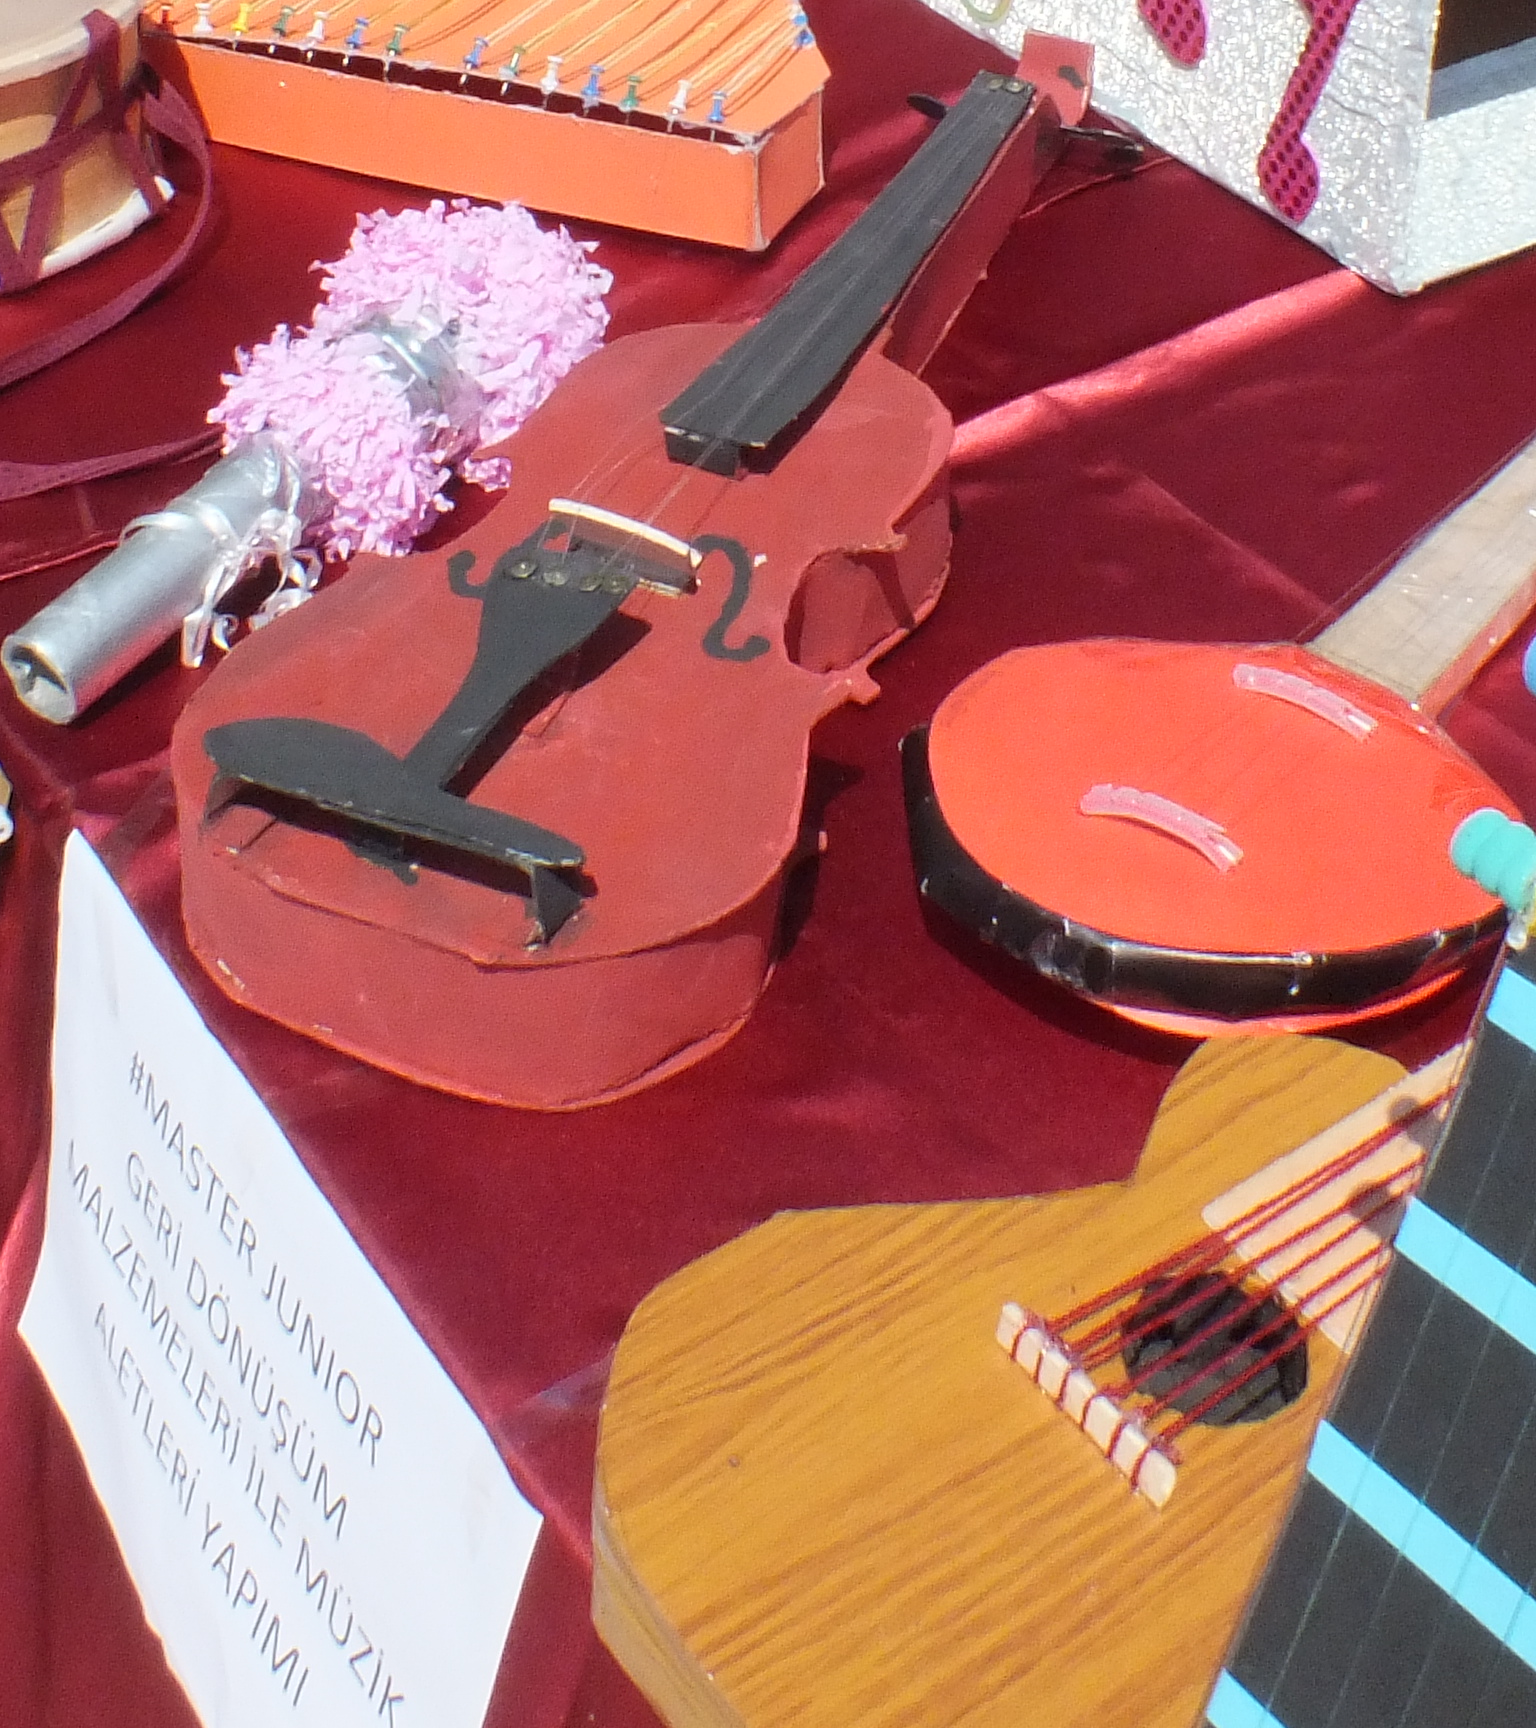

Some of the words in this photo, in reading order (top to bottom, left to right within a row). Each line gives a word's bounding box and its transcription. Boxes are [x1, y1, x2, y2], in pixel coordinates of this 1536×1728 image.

[69, 1139, 243, 1465] MALZEMELERİ
[245, 1444, 288, 1548] İLE
[295, 1537, 405, 1727] MÜZİK
[128, 1150, 183, 1270] GERİ
[186, 1257, 348, 1541] DÖNÜŞÜM
[129, 1051, 257, 1275] #MASTER
[262, 1261, 384, 1467] JUNIOR
[94, 1301, 200, 1517] ALETLERİ
[201, 1503, 310, 1707] YAPIMI
